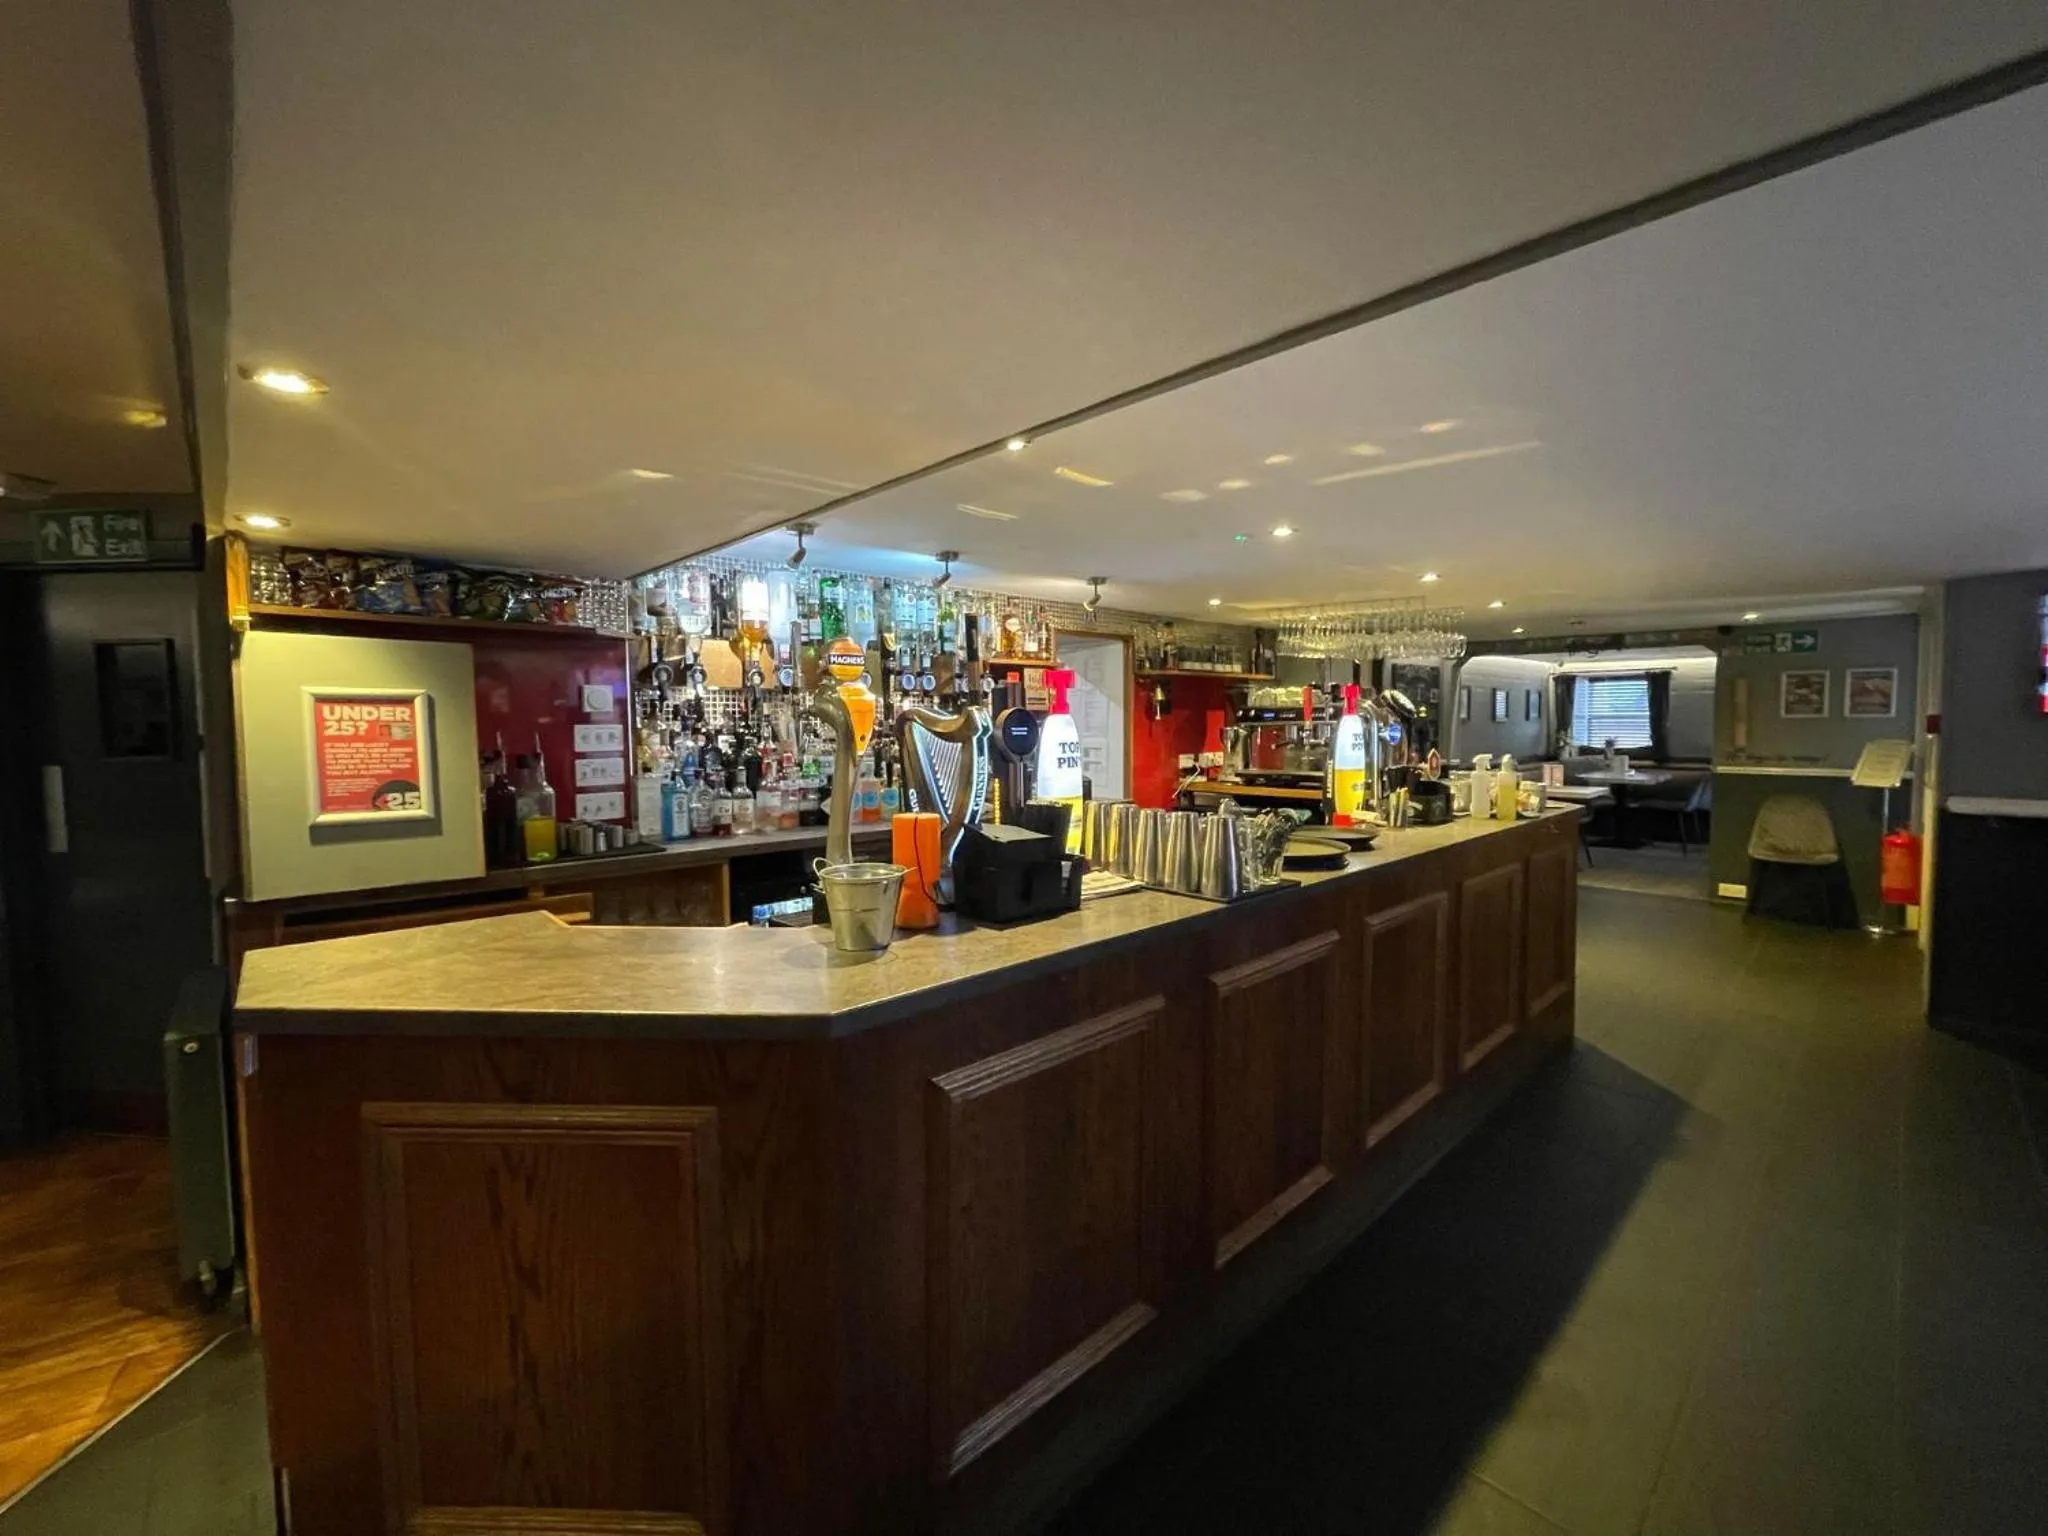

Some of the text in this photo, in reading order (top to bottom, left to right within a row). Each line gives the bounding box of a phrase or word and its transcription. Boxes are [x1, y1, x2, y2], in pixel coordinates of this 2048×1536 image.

[322, 704, 411, 721] UNDER
[323, 720, 369, 737] 25?
[387, 792, 420, 809] 25
